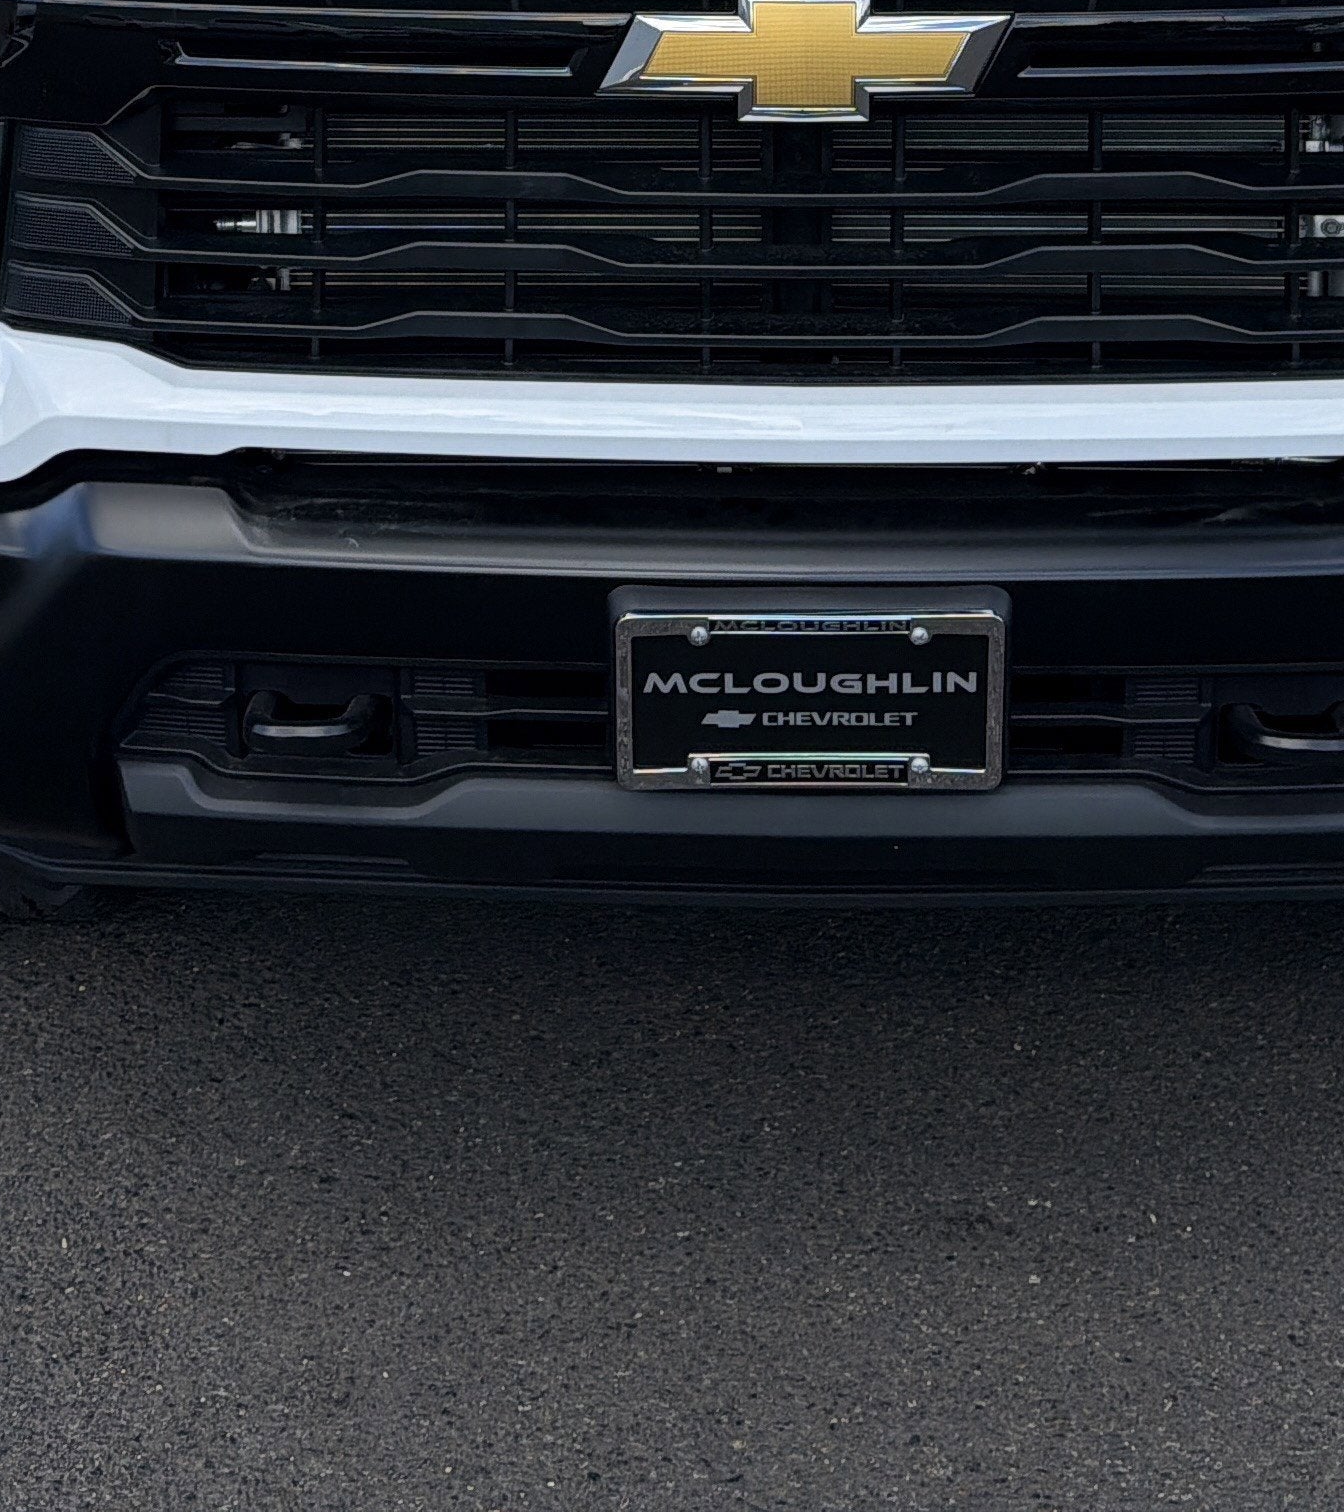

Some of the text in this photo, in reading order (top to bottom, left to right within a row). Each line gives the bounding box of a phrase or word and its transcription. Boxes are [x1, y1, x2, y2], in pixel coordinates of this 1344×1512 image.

[714, 620, 906, 632] MCLOUGHLIN
[643, 672, 978, 694] MCLOUGHLIN
[762, 712, 918, 726] CHEVROLET
[767, 764, 905, 779] CHEVROLET
